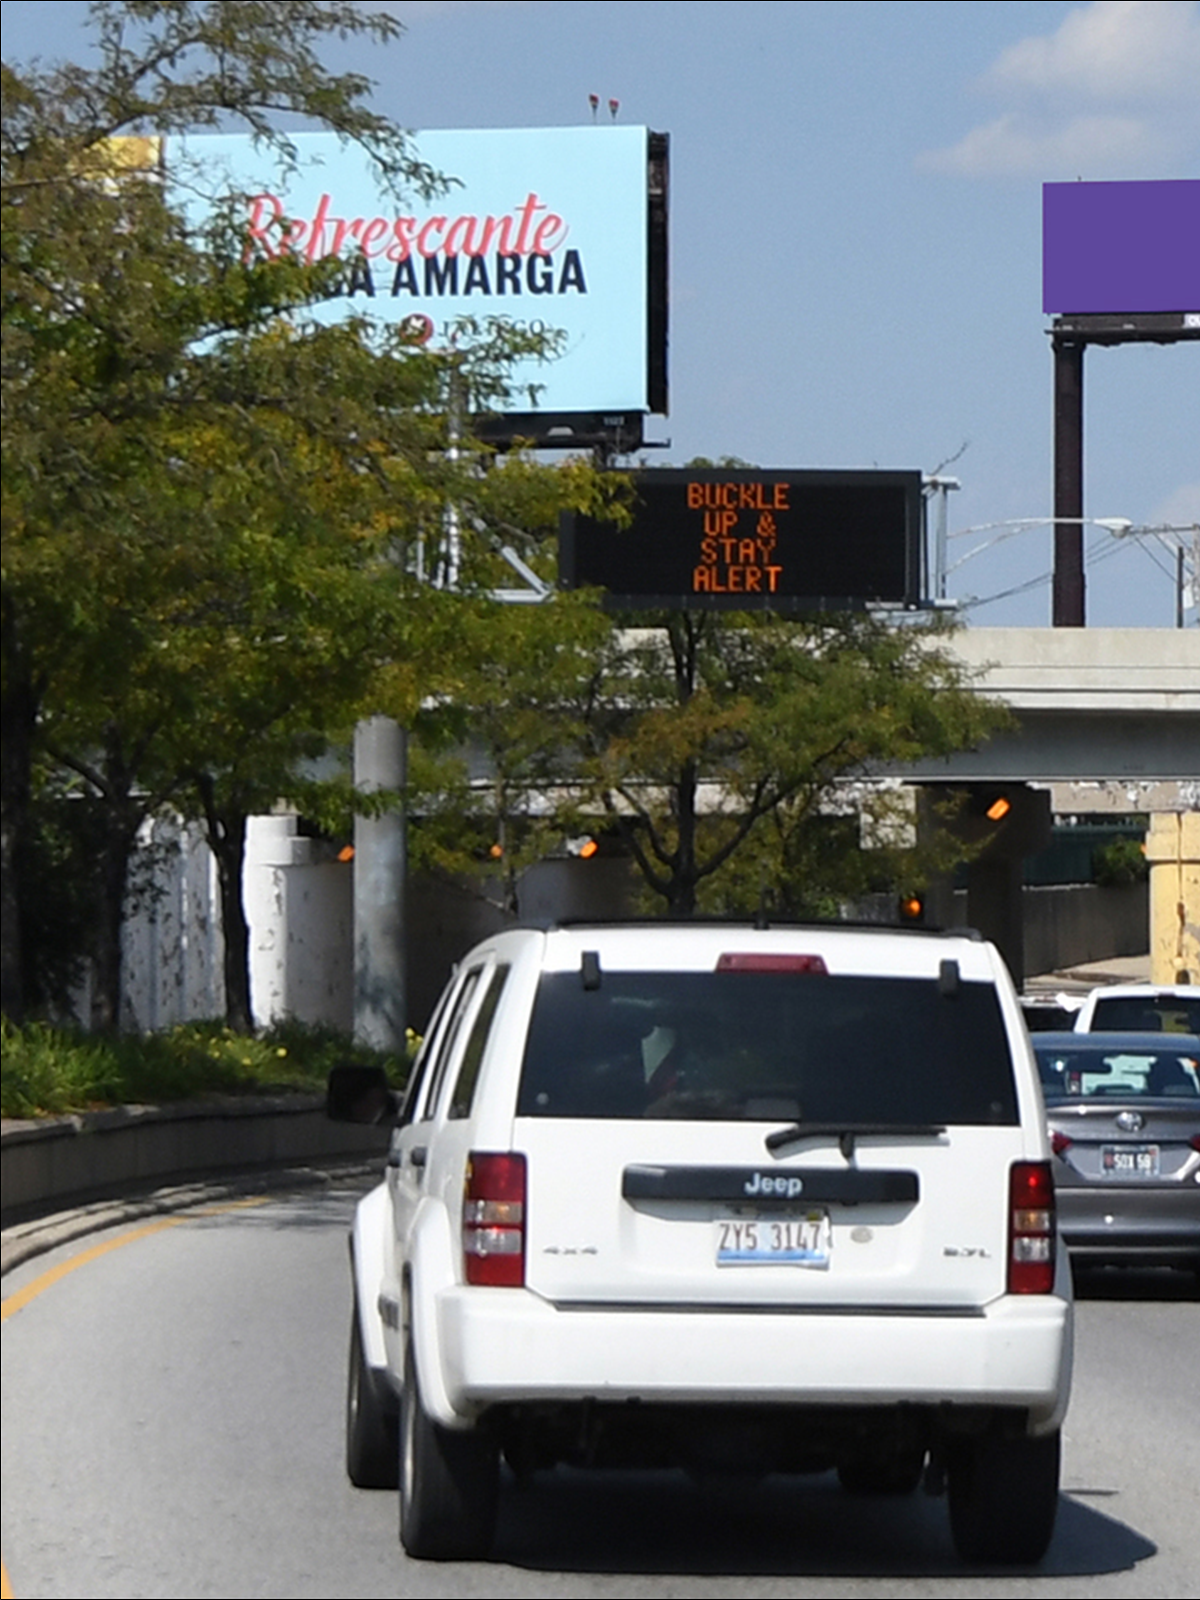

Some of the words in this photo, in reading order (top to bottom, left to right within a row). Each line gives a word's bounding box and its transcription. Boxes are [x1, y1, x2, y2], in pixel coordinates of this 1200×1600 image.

[242, 193, 569, 266] Refrescante
[391, 250, 588, 298] AMARGA
[687, 483, 790, 510] BUCKLE
[704, 511, 738, 537] UP
[756, 512, 776, 537] &
[701, 538, 776, 564] STAY
[693, 566, 782, 592] ALERT
[744, 1172, 803, 1198] Jeep
[719, 1223, 757, 1250] ZY5
[771, 1223, 821, 1251] 3147
